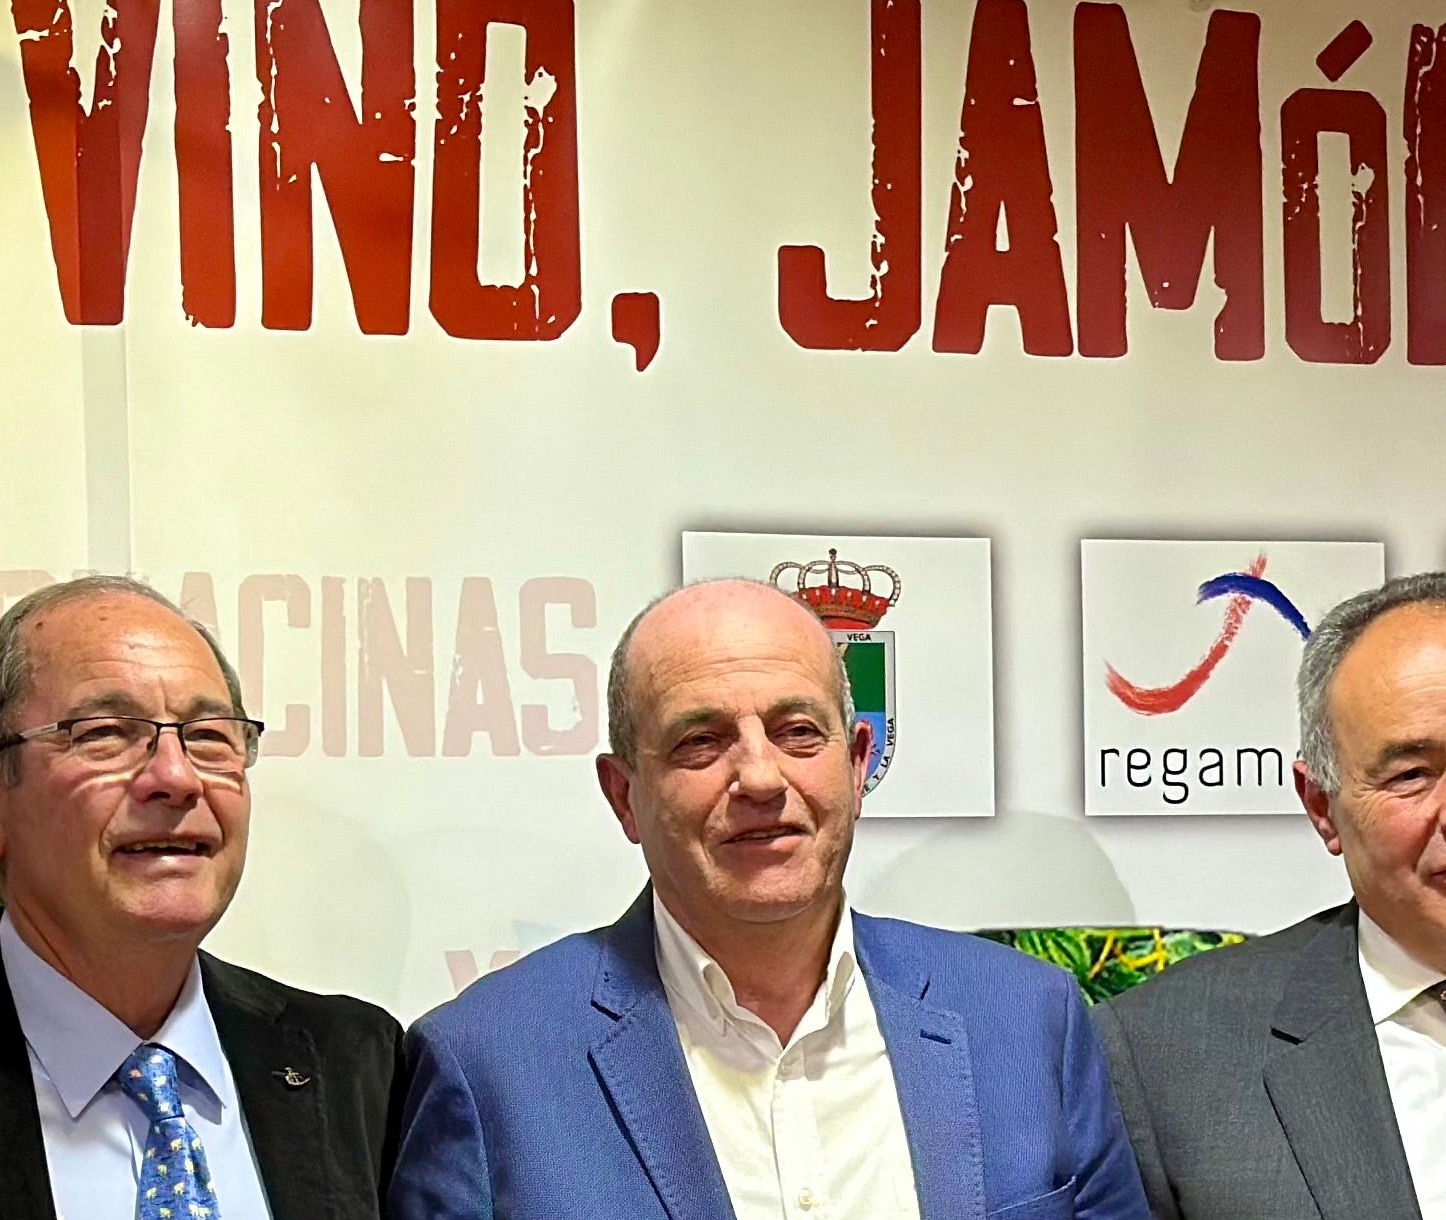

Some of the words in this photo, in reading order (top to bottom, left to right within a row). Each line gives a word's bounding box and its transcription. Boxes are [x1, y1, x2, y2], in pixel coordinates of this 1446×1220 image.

[10, 0, 661, 373] VINO,
[847, 633, 872, 642] VEGA
[1100, 748, 1300, 805] regam
